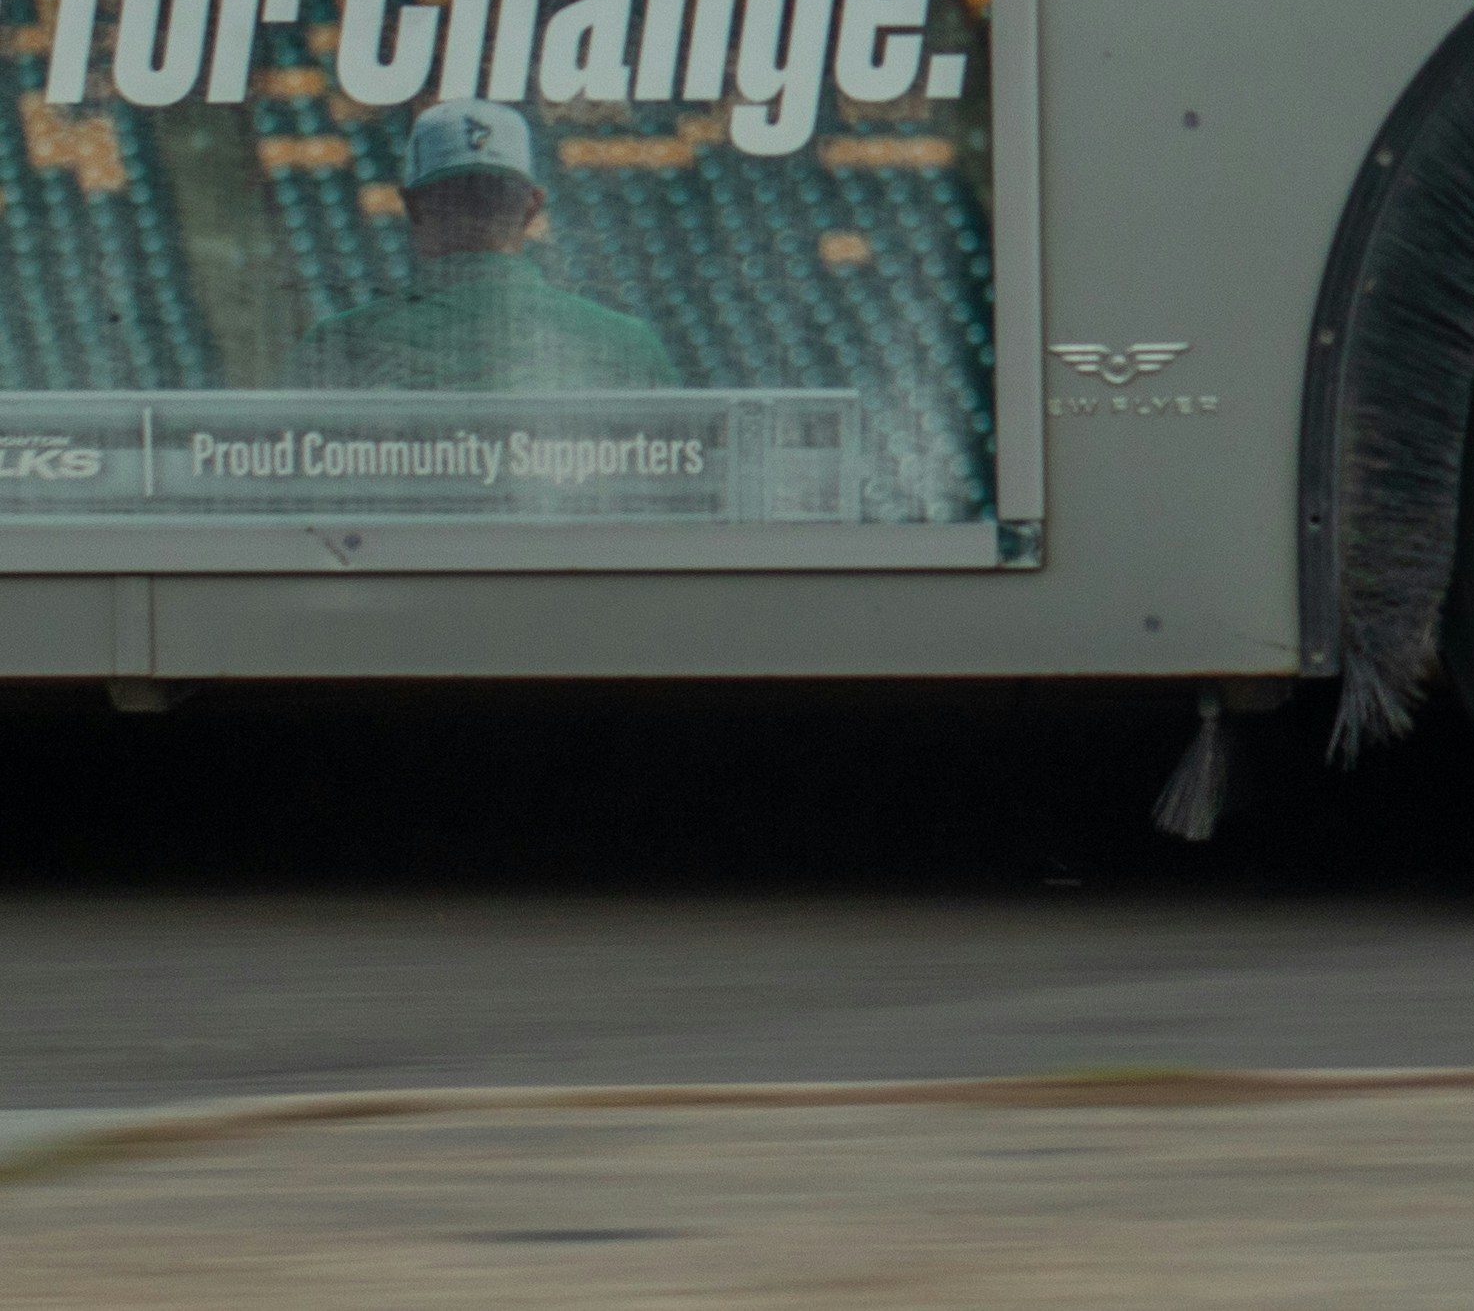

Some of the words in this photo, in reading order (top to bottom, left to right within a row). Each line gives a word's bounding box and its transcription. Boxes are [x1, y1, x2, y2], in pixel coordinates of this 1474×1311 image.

[192, 429, 295, 477] Proud
[301, 430, 501, 487] Community
[508, 430, 705, 485] Supporters
